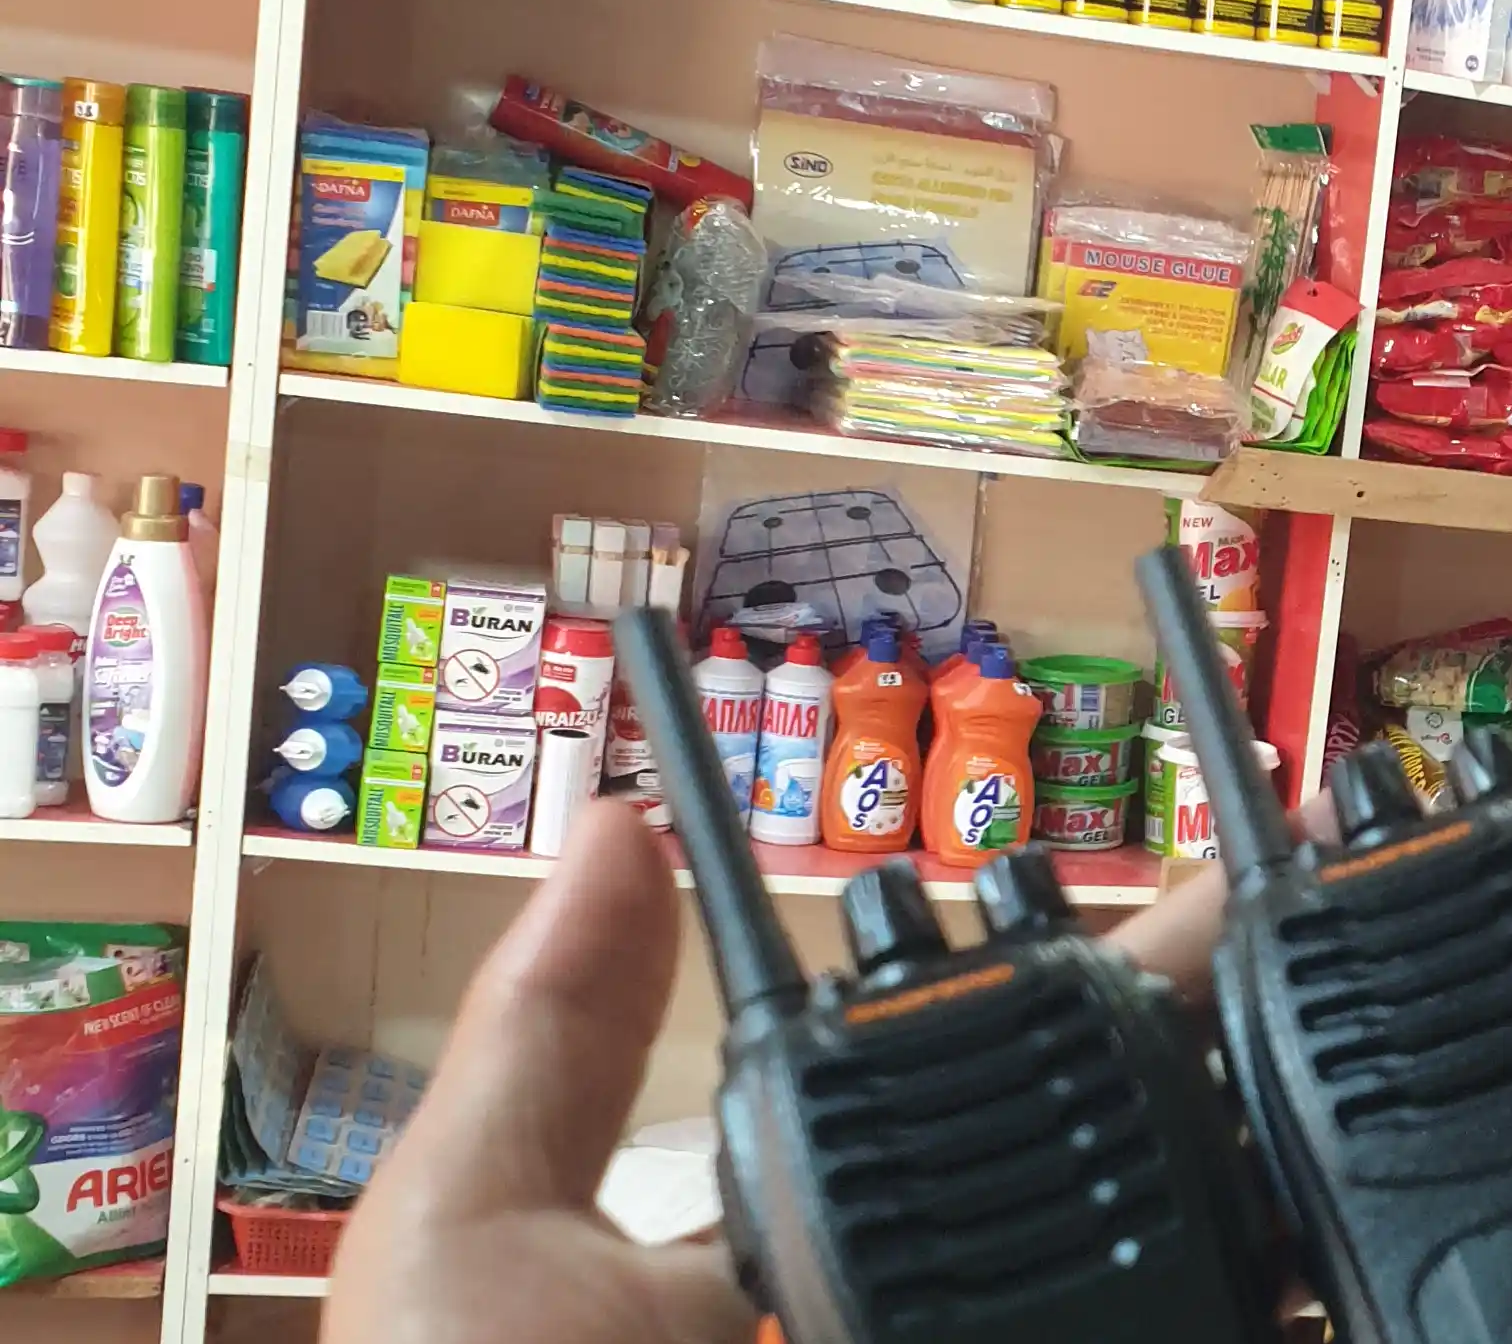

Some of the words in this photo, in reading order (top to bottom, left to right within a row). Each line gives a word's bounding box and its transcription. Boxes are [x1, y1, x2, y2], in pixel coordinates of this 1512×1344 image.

[450, 206, 496, 222] DAFNA
[1085, 248, 1165, 274] MOUSE
[1171, 261, 1232, 283] GLUE
[1182, 517, 1214, 529] NEW
[1196, 584, 1221, 601] EL
[102, 624, 148, 642] Bright
[380, 602, 405, 662] MOSQUITALL
[450, 607, 533, 634] BURAN
[374, 691, 397, 748] MOSQUITALL
[702, 697, 762, 734] АПЛЯ
[762, 697, 819, 738] АПЛЯ
[440, 743, 524, 768] BURAN
[1036, 743, 1120, 785] Max!
[852, 759, 888, 829] AOS
[963, 775, 1001, 844] AOS
[361, 787, 385, 846] MOSQUITALL
[1040, 799, 1120, 836] Max!
[1082, 831, 1110, 844] GEL
[66, 1149, 173, 1214] ARIE
